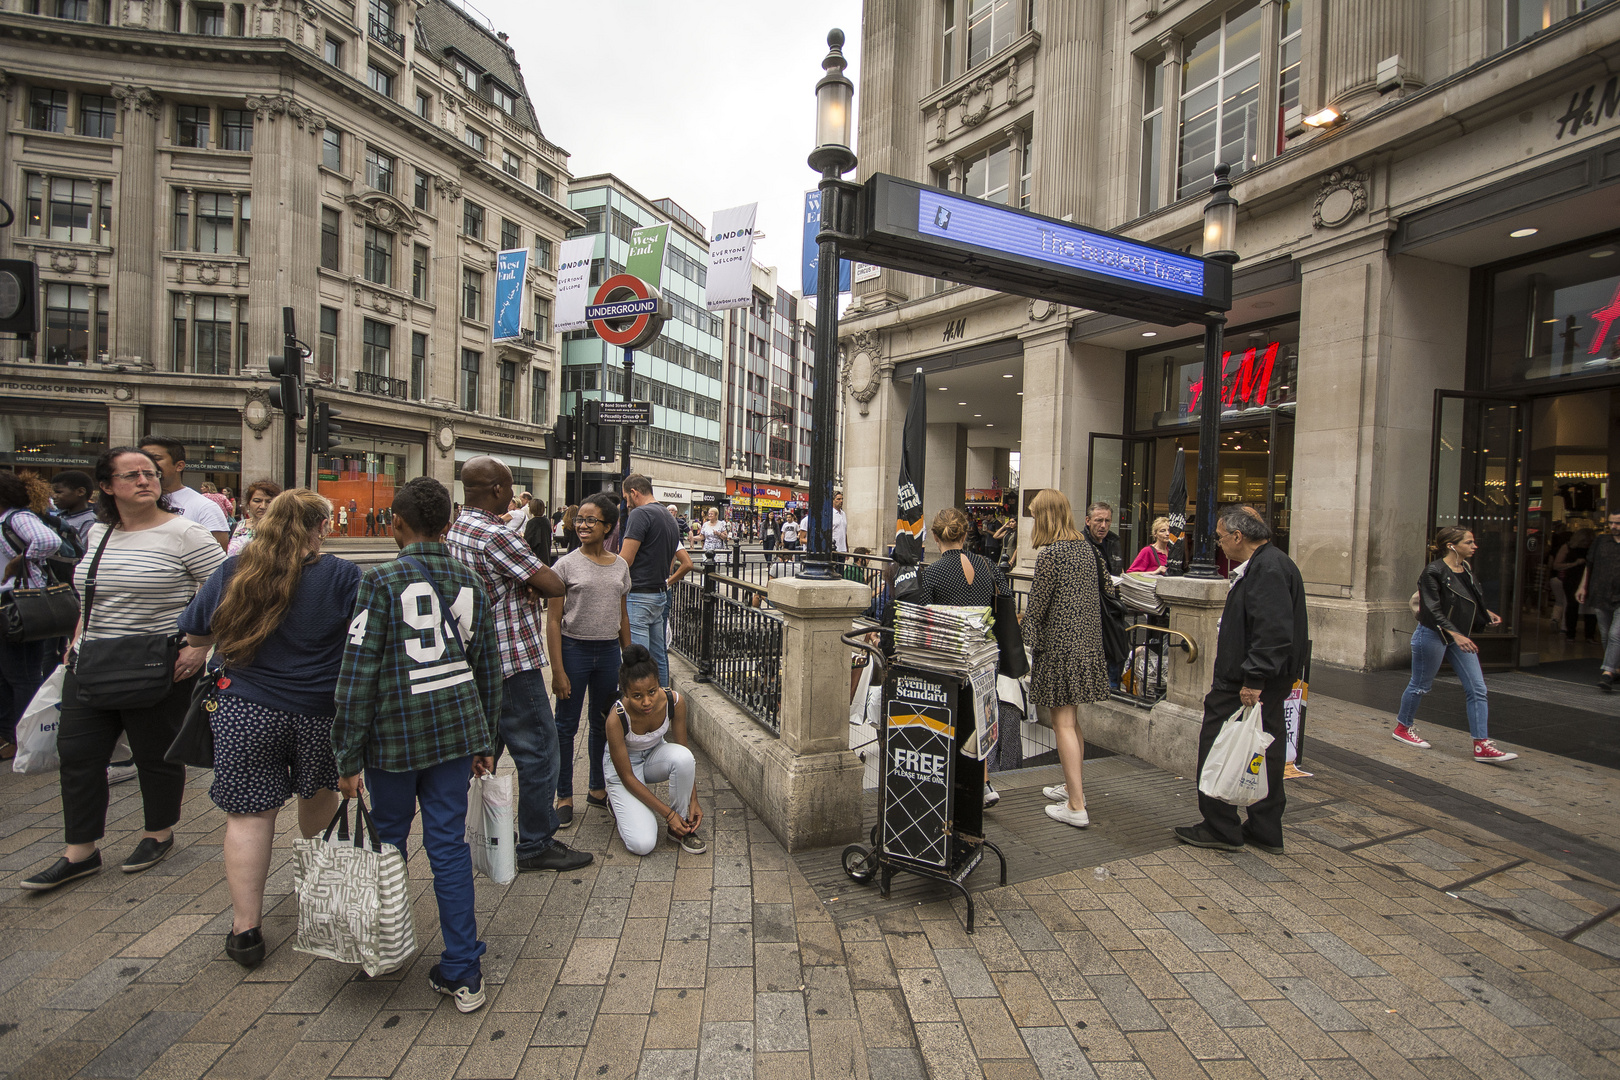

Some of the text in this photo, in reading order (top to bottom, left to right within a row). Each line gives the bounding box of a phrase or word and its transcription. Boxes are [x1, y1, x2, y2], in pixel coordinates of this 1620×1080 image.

[632, 234, 659, 246] West
[710, 227, 752, 242] LONDON
[629, 244, 654, 257] End.
[712, 246, 746, 257] EVERYONE
[1037, 226, 1075, 257] The
[1081, 238, 1150, 275] busiest
[1154, 258, 1192, 284] time
[499, 260, 520, 270] West
[558, 258, 590, 271] LONDON
[713, 255, 743, 265] WELCOME
[498, 269, 516, 281] End.
[857, 267, 872, 275] CIRCUS
[558, 275, 583, 285] EVERYONE
[559, 284, 581, 292] WELCOME
[588, 301, 655, 317] UNDERGROUND
[943, 317, 967, 342] H&M
[0, 382, 19, 390] ITED
[20, 383, 52, 392] COLORS
[663, 491, 683, 499] PANDORA
[348, 608, 369, 646] 4
[400, 581, 475, 664] 94
[897, 677, 942, 694] Evening
[896, 687, 948, 703] Standard
[894, 748, 945, 777] FREE
[894, 770, 945, 785] PLEASE TAKE ONE
